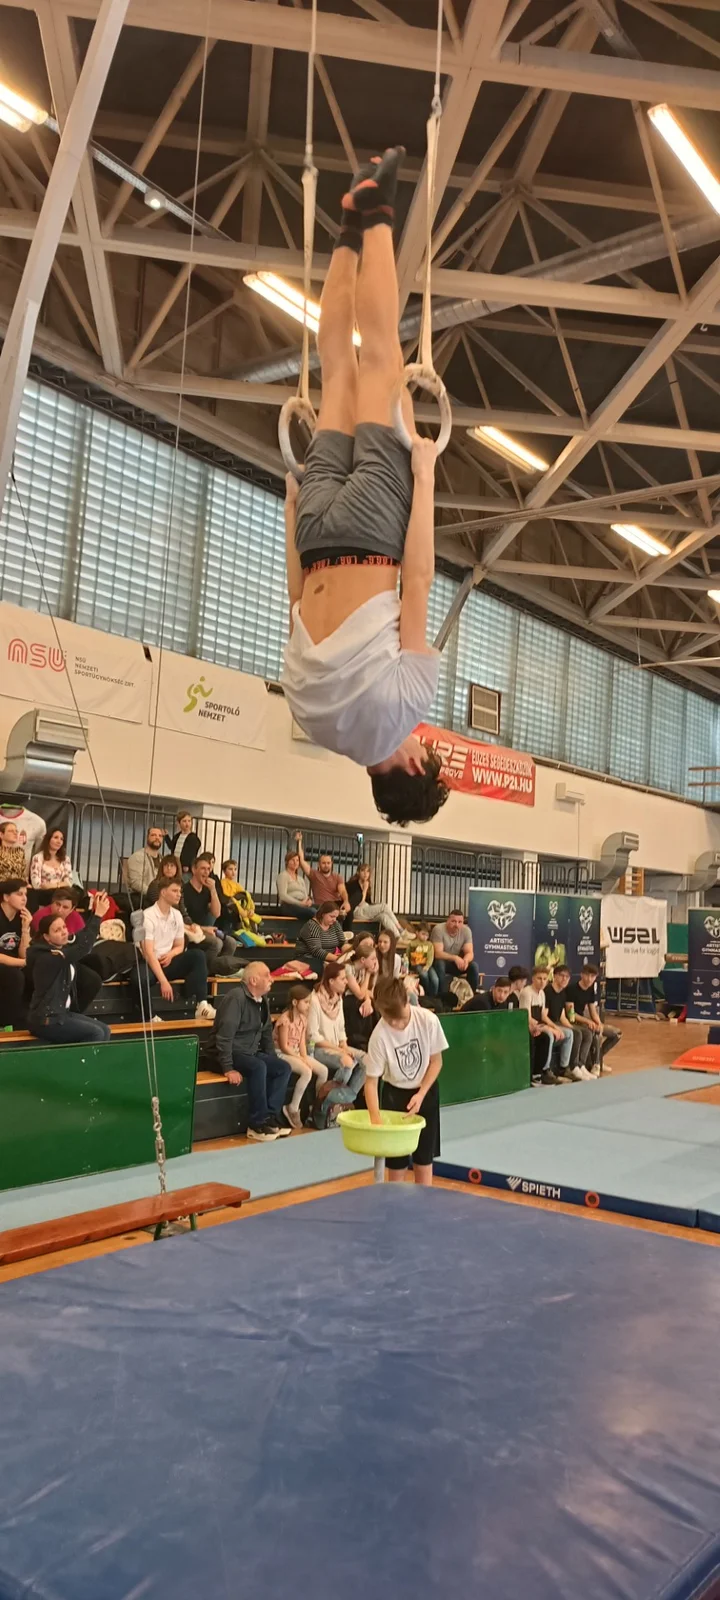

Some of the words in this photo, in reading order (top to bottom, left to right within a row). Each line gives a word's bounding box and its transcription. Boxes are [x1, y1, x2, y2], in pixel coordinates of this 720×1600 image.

[75, 663, 99, 673] NEMZETI
[205, 701, 240, 716] SPORTOLÓ
[198, 709, 226, 723] NEMZET
[522, 1181, 561, 1199] SPIETH
